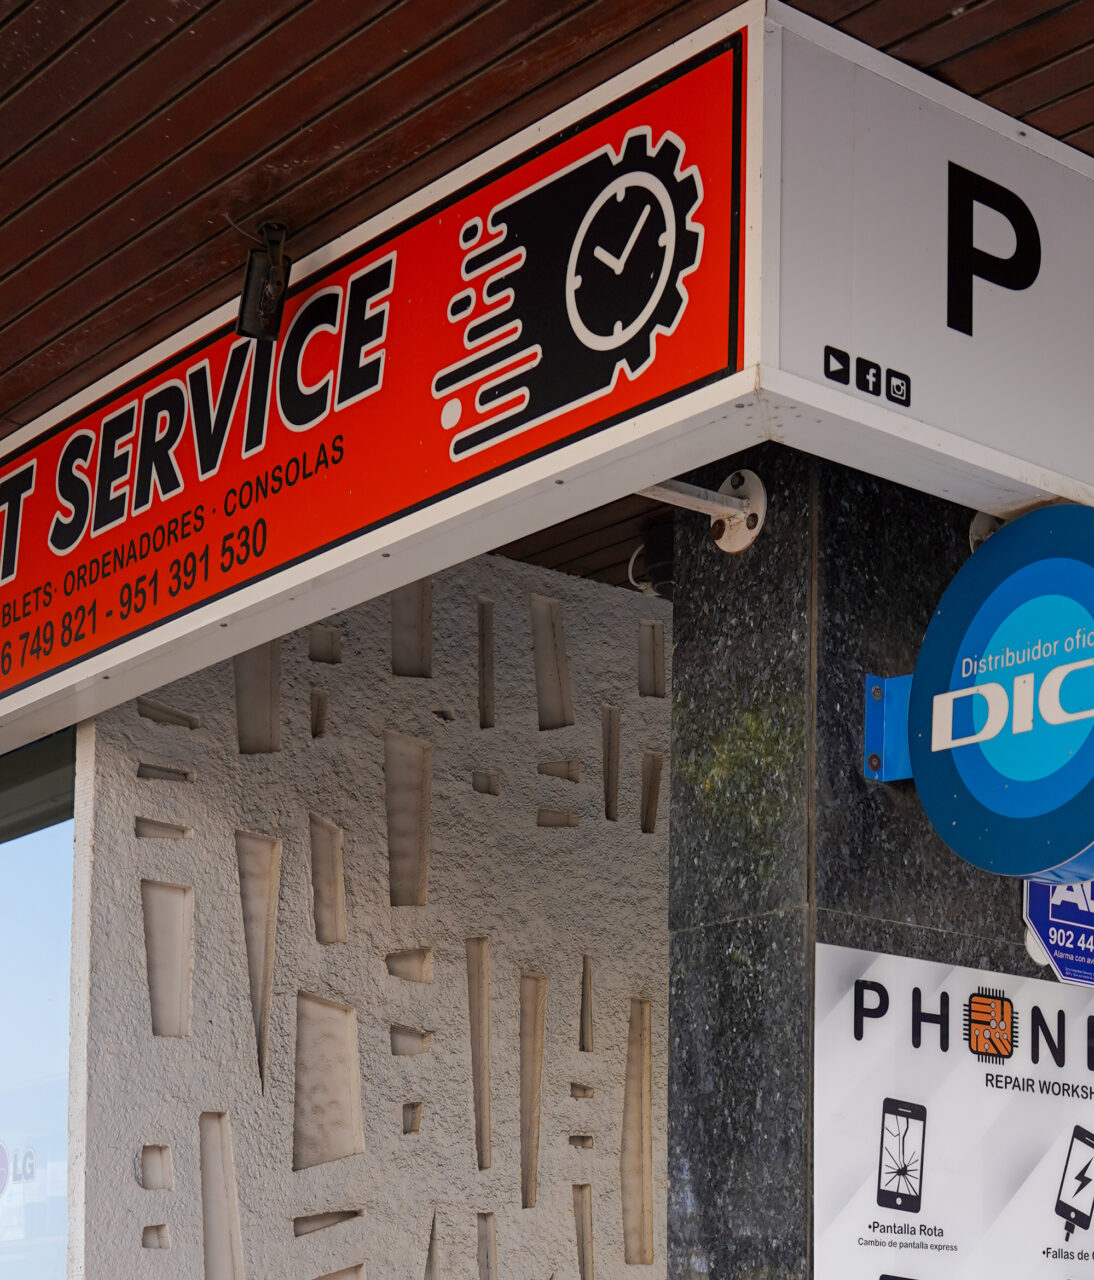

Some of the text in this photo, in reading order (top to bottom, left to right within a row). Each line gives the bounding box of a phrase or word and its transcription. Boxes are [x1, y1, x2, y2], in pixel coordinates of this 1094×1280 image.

[47, 250, 398, 557] SERVICE
[63, 505, 205, 596] ORDENADORES
[223, 434, 345, 517] CONSOLAS
[19, 621, 55, 670] 749
[61, 598, 98, 648] 821
[119, 572, 160, 622] 951
[168, 547, 211, 596] 391
[219, 516, 268, 573] 530
[961, 639, 1058, 679] Distribuidor
[1049, 926, 1075, 949] 902
[1053, 949, 1074, 961] Alarma
[1075, 955, 1086, 964] con
[985, 1073, 1035, 1094] REPAIR
[13, 1149, 35, 1182] LG
[919, 1225, 944, 1238] Rota
[858, 1237, 958, 1253] Cambio de pantalla express
[1077, 1249, 1090, 1261] de
